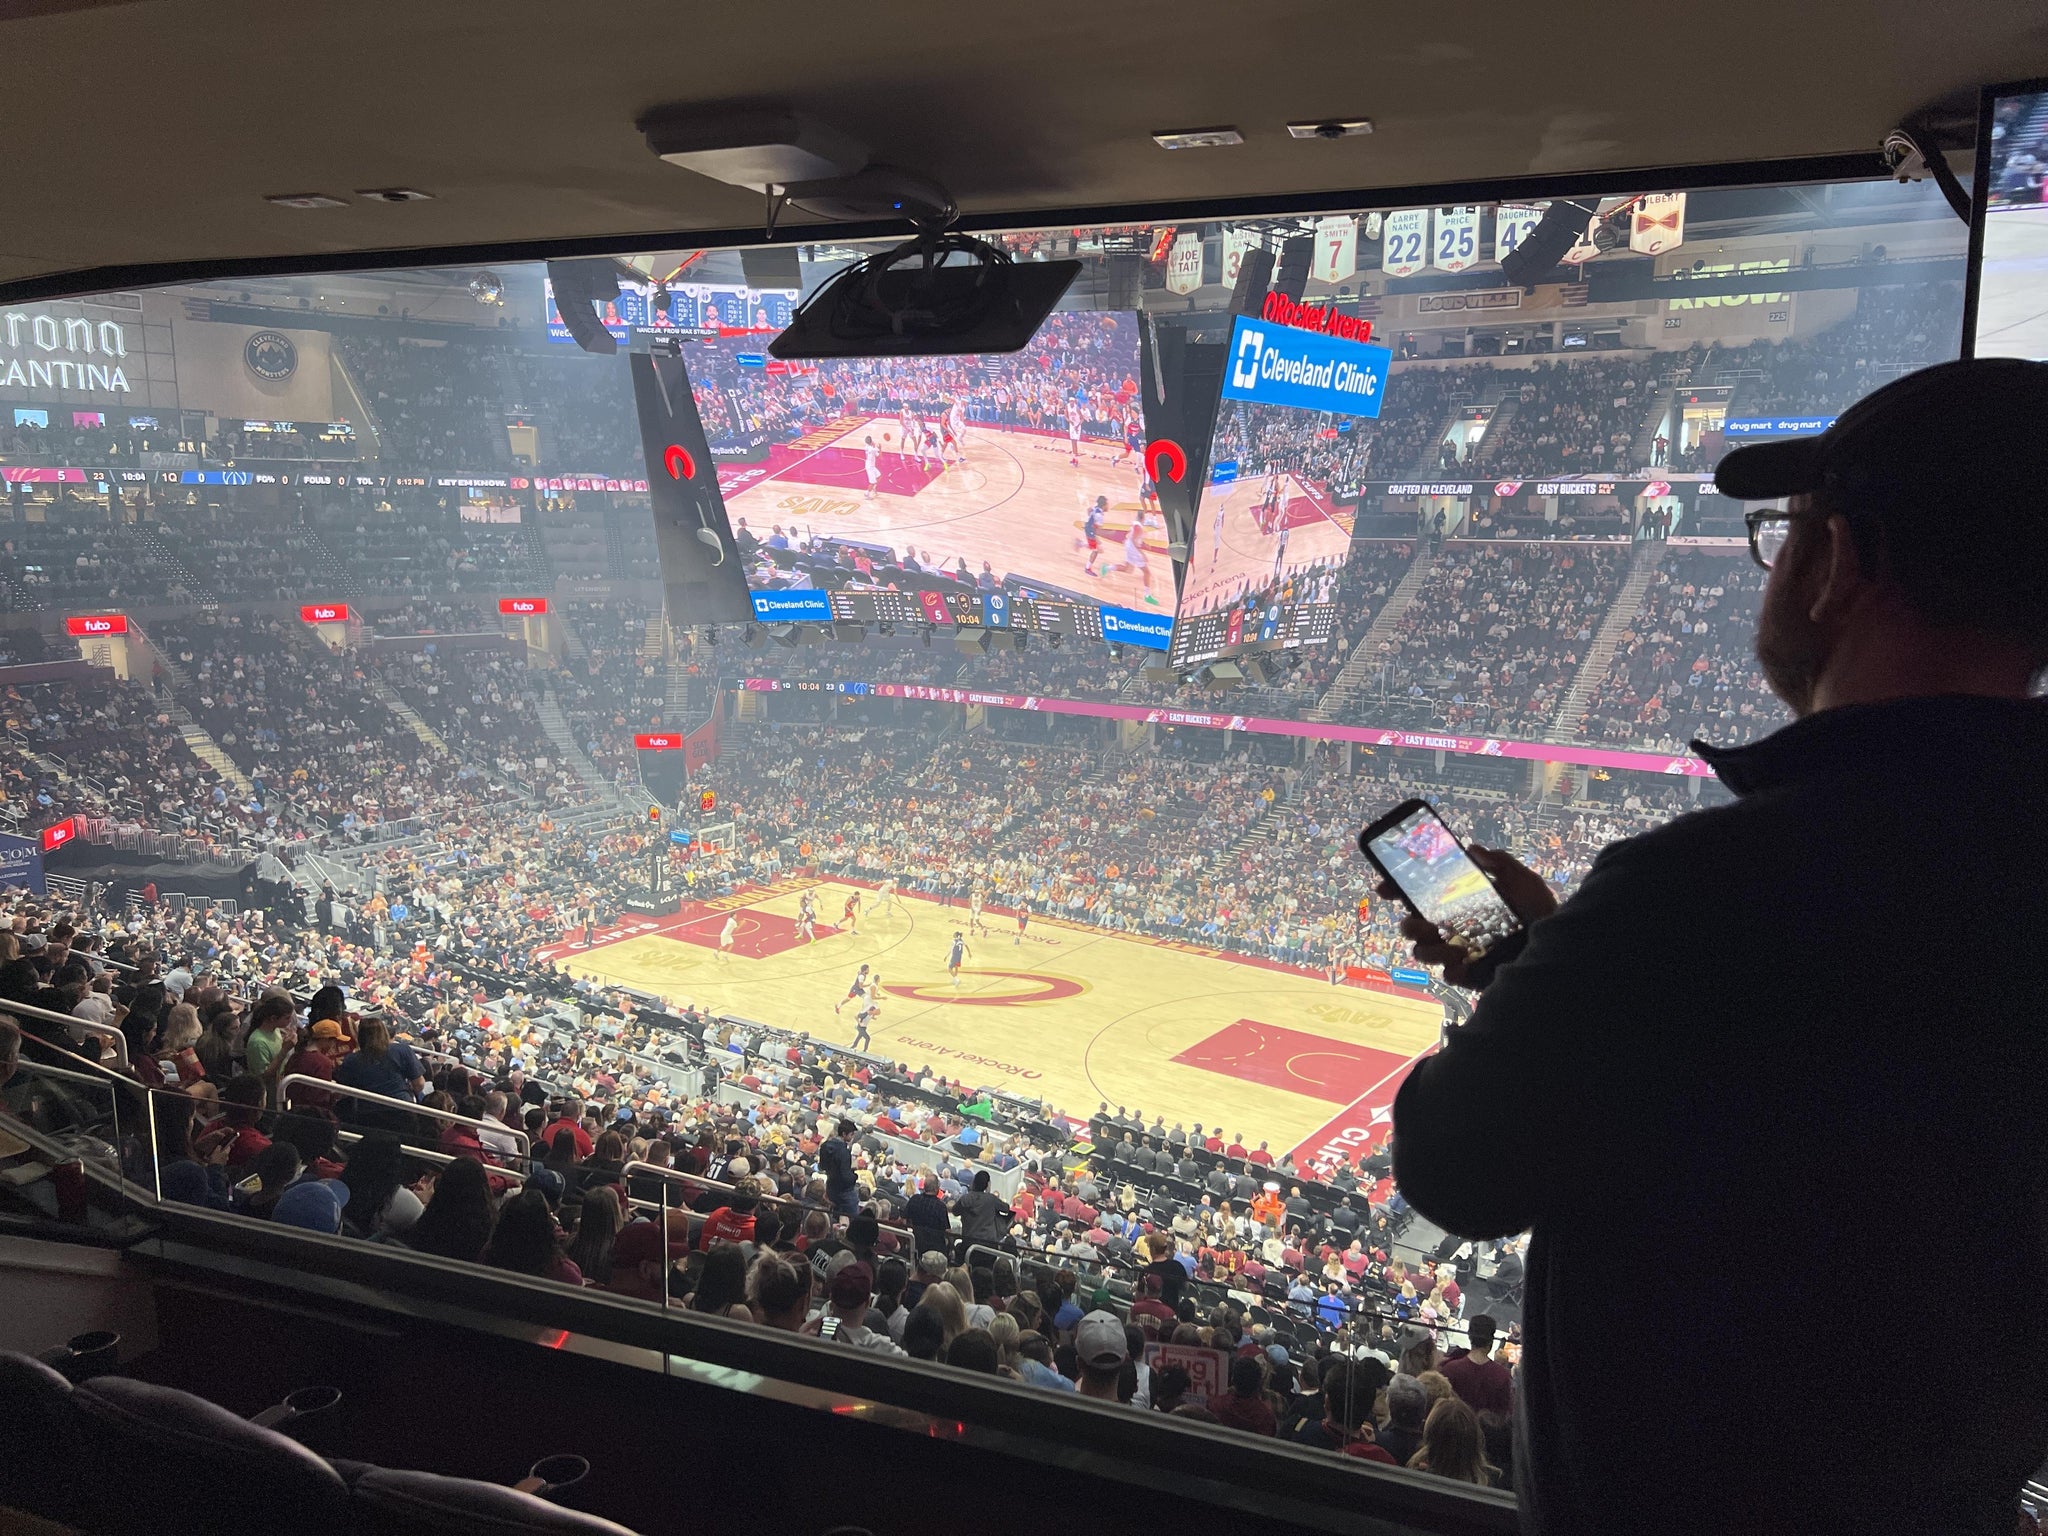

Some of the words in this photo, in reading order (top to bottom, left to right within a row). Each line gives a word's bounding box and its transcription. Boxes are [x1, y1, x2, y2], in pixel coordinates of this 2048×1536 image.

[1645, 193, 1680, 205] ILBERT
[1392, 214, 1420, 224] LARRY
[1445, 216, 1470, 226] PRICE
[1391, 222, 1419, 232] NANCE
[1324, 230, 1348, 238] SMITH
[1387, 232, 1421, 265] 22
[1439, 226, 1474, 260] 25
[1180, 249, 1198, 261] JOE
[1329, 240, 1343, 269] 7
[1178, 261, 1199, 273] TAIT
[1325, 307, 1373, 344] Arena
[0, 312, 128, 358] rona
[252, 335, 289, 349] CLEVELAND
[255, 365, 290, 378] MONSTERS
[1261, 347, 1331, 389] Cleveland
[1334, 361, 1377, 396] Clinic
[1729, 422, 1750, 432] drug
[1751, 422, 1772, 430] mart
[1778, 421, 1799, 431] drug
[1800, 420, 1822, 429] mart
[57, 470, 66, 480] 5
[93, 472, 105, 480] 23
[121, 472, 146, 482] 10:04
[162, 473, 177, 482] 1Q
[198, 472, 205, 483] 0
[281, 475, 289, 485] 0
[303, 476, 331, 485] FOULS
[338, 477, 345, 486] 0
[356, 477, 373, 486] TOL
[379, 477, 386, 486] 7
[1387, 484, 1420, 495] CRAFTED
[1421, 484, 1430, 495] IN
[1431, 484, 1473, 495] CLEVELAND
[1536, 483, 1559, 495] EASY
[1559, 483, 1597, 495] BUCKETS
[513, 602, 534, 611] fubo
[768, 600, 804, 611] Cleveland
[804, 601, 825, 609] Clinic
[314, 607, 336, 619] fubo
[934, 609, 943, 621] 5
[991, 613, 999, 624] 0
[84, 619, 111, 632] fubo
[955, 614, 980, 625] 10:04
[1118, 619, 1155, 635] Cleveland
[1264, 626, 1271, 639] 0
[1230, 631, 1237, 643] 5
[771, 681, 778, 690] 5
[797, 682, 820, 691] 10:04
[825, 683, 835, 691] 23
[838, 683, 845, 692] 0
[968, 693, 982, 703] EASY
[982, 695, 1005, 705] BUCKETS
[1168, 712, 1185, 723] EASY
[1185, 714, 1212, 725] BUCKETS
[649, 738, 668, 746] fubo
[1405, 735, 1424, 746] EASY
[1425, 736, 1457, 749] BUCKETS
[703, 877, 825, 911] CAVALIERS
[896, 1035, 954, 1056] Arena
[953, 1051, 1024, 1076] Rocket
